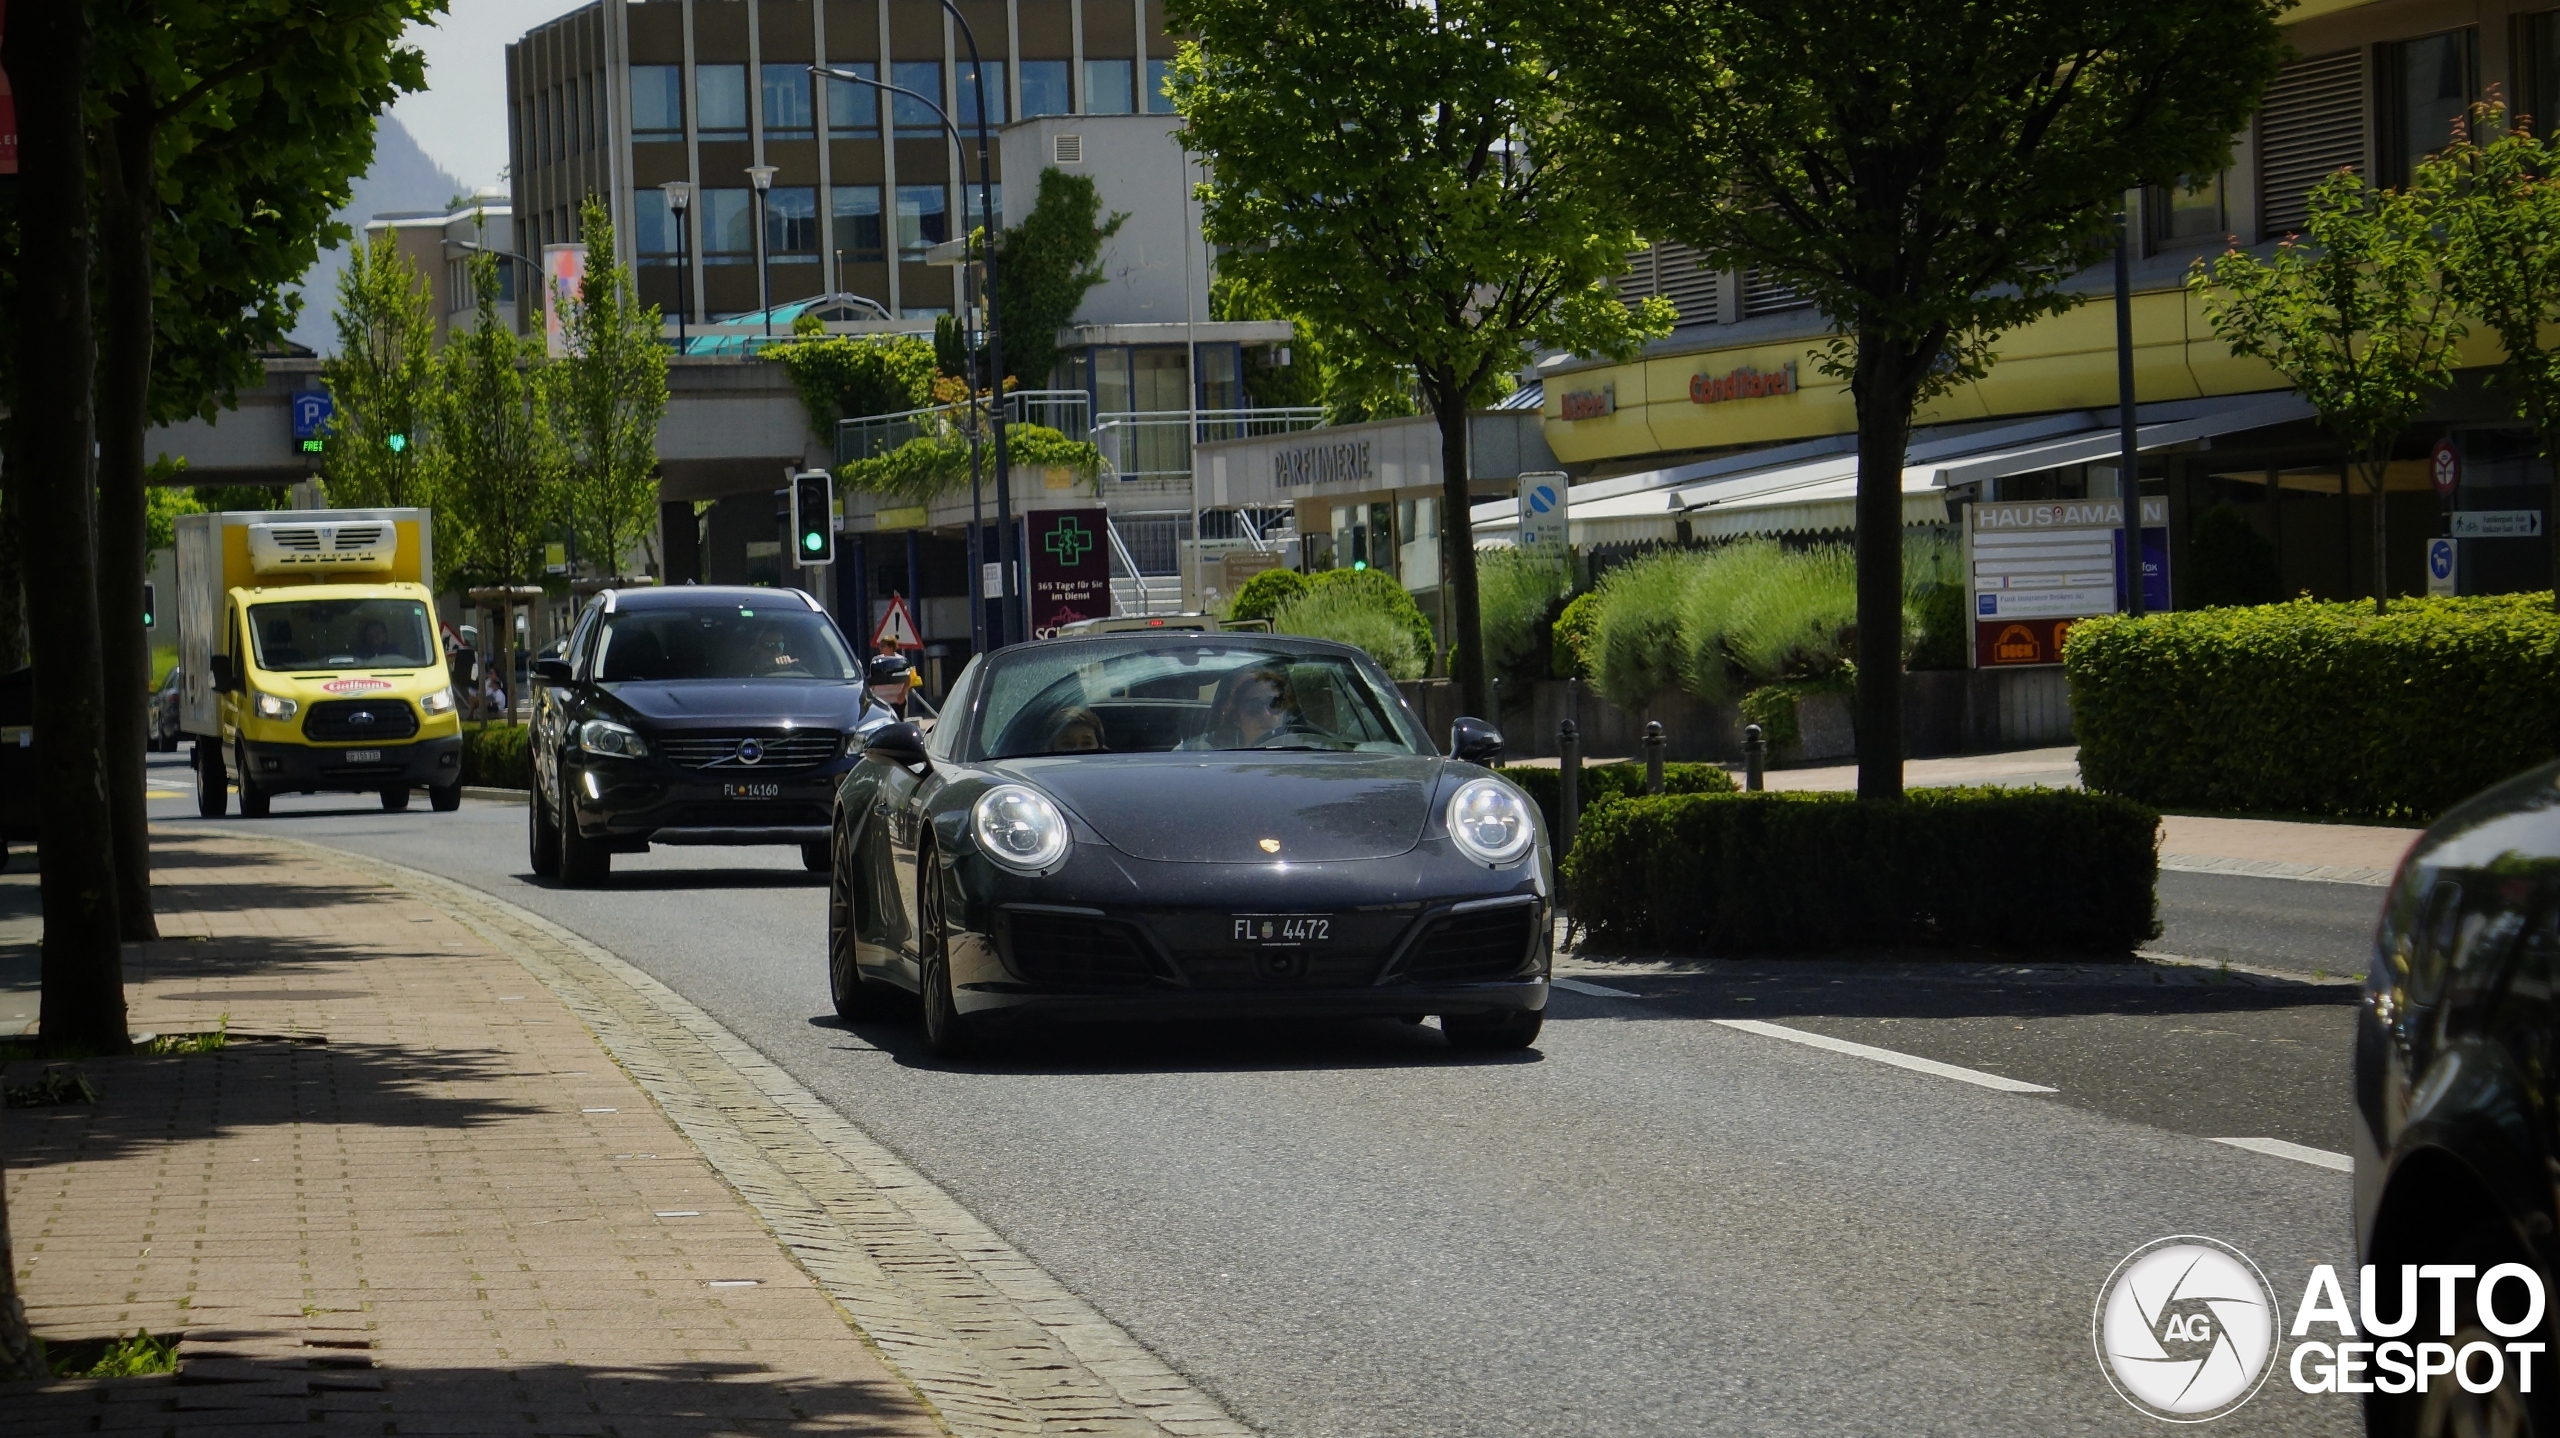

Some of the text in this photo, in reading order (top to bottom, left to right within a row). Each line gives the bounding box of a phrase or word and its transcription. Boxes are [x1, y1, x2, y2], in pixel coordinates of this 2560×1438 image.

[1689, 360, 1797, 404] Conditorei
[304, 402, 319, 425] P
[1275, 441, 1373, 488] PARFUMERIE
[1980, 502, 2162, 527] HAUS AMAN
[1038, 580, 1104, 591] 365 Tage für Sie
[1051, 592, 1090, 601] im Dienst
[328, 680, 384, 691] Galbani
[724, 783, 778, 796] FL 14160
[1234, 919, 1330, 940] FL 4472
